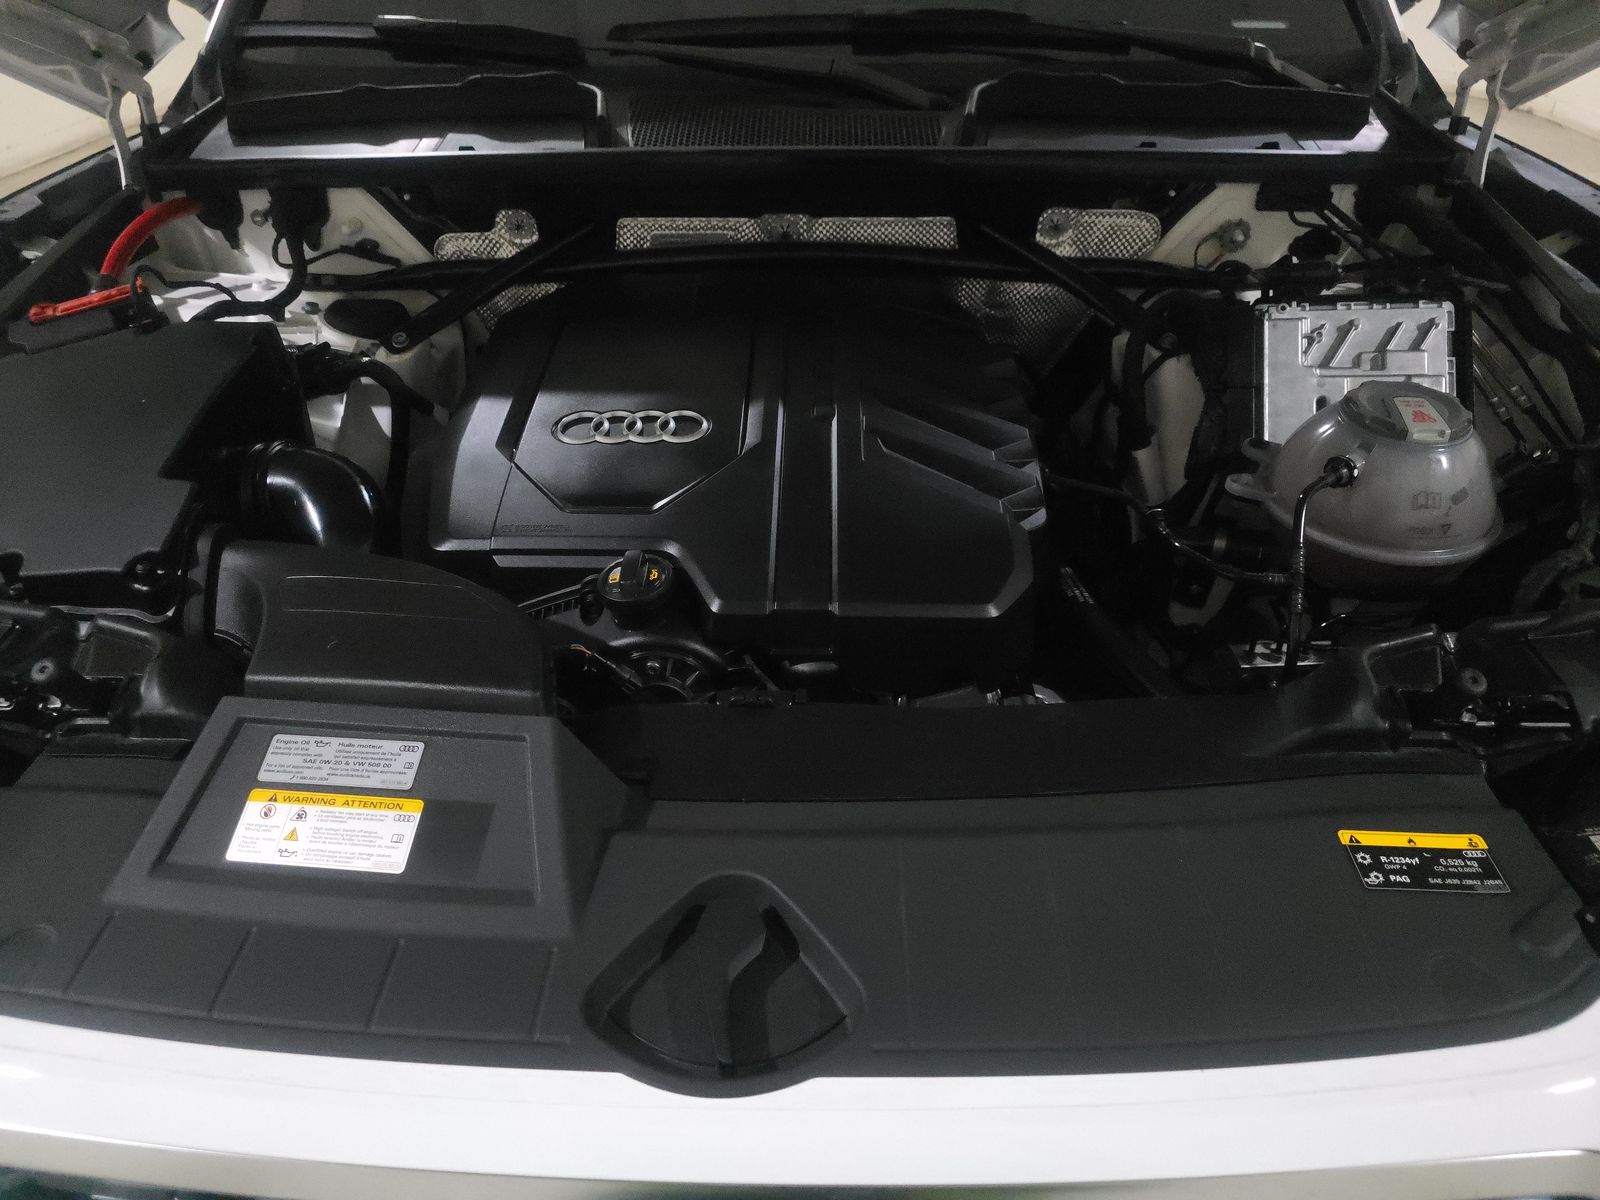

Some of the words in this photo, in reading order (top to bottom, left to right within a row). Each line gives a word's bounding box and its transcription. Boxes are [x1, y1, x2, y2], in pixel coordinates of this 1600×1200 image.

[283, 795, 336, 806] WARNING
[342, 799, 404, 810] ATTENTION
[1380, 856, 1420, 866] R-1234yf
[1465, 859, 1479, 867] kg
[1389, 875, 1411, 883] PAG
